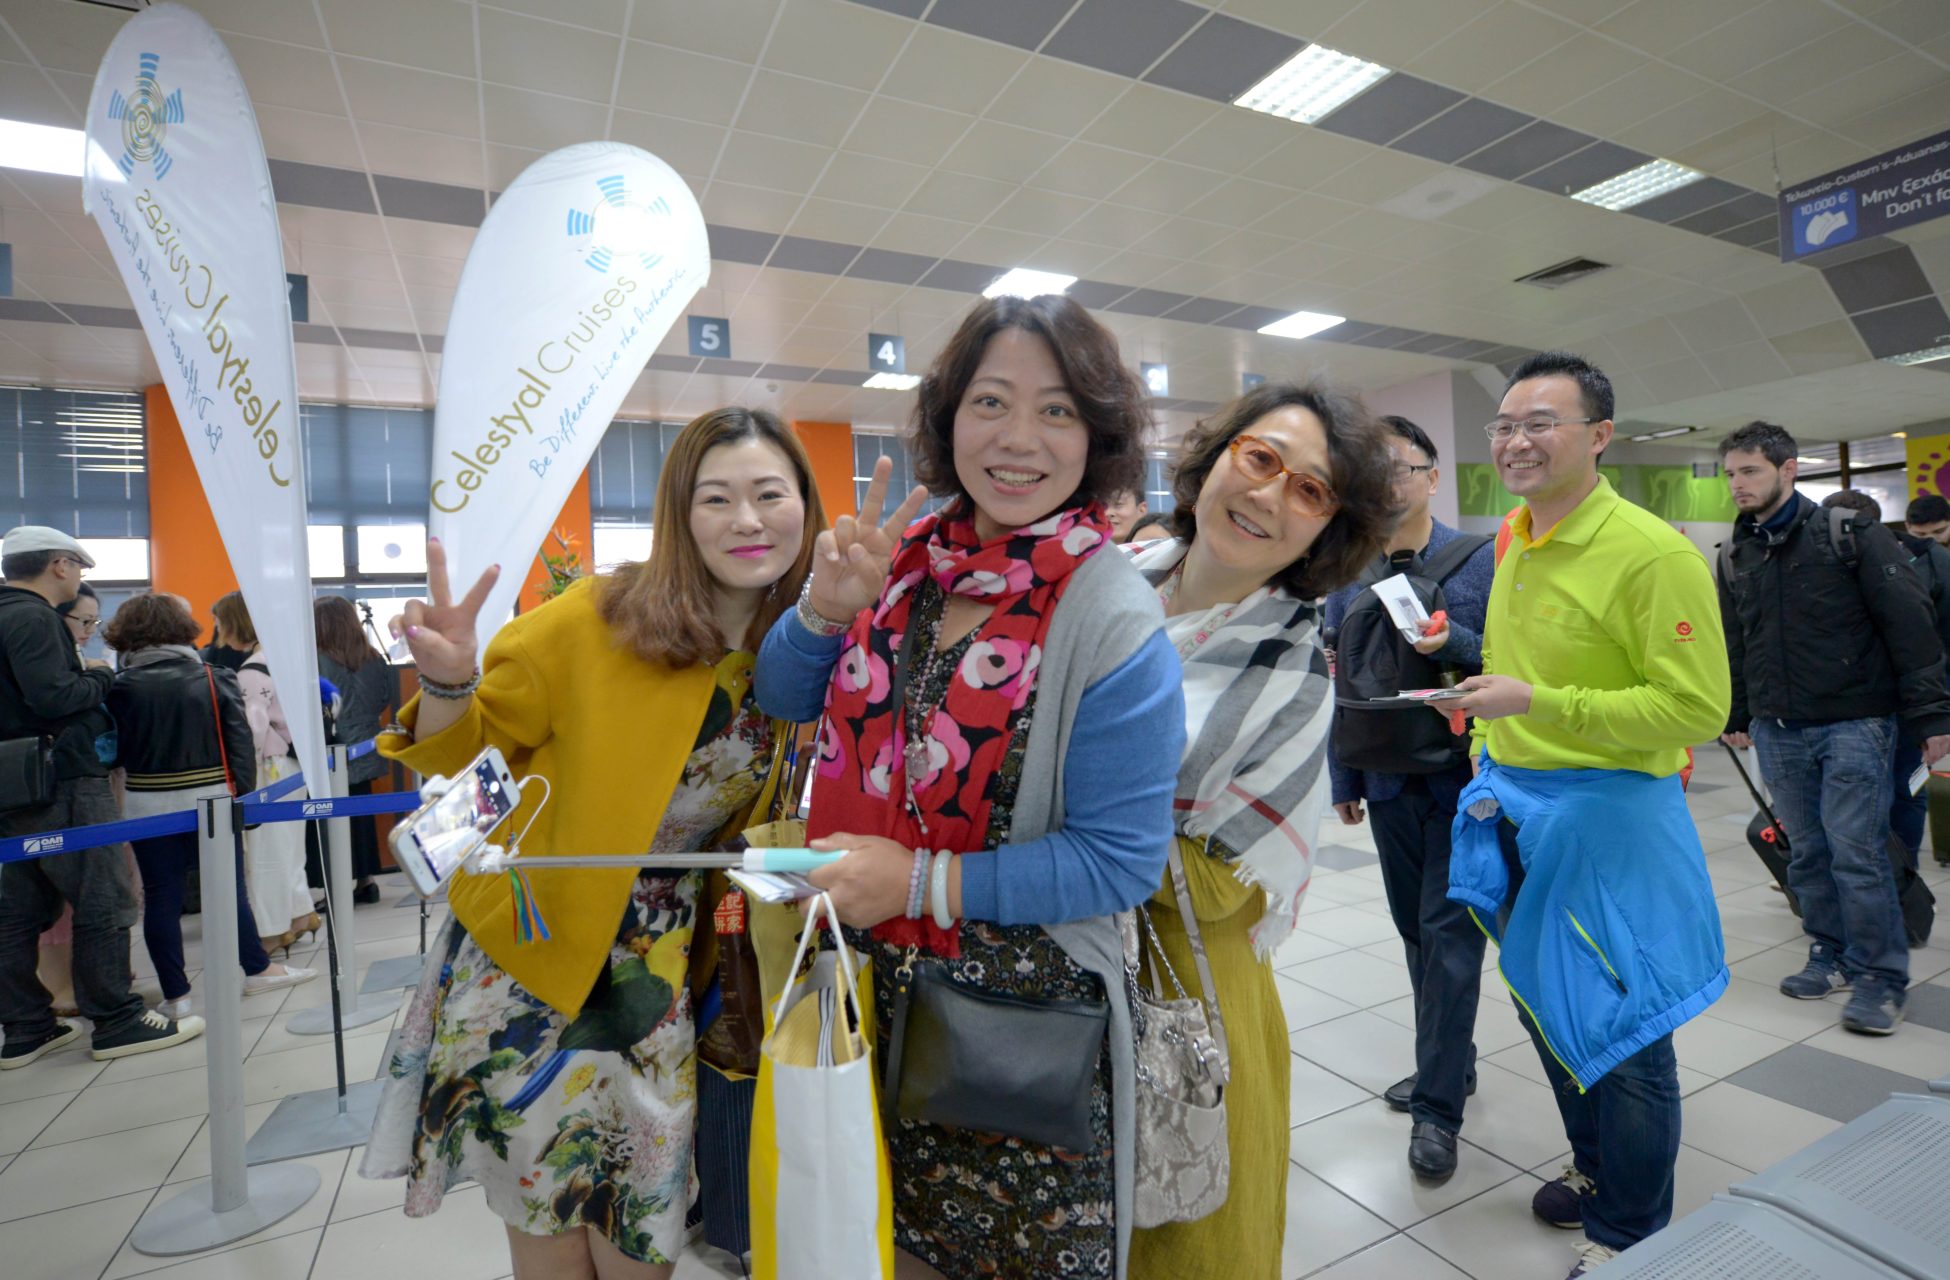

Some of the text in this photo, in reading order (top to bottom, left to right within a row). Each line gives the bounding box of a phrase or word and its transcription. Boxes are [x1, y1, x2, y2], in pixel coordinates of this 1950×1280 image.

[700, 323, 720, 351] 5
[877, 340, 896, 366] 4
[430, 276, 637, 514] Celestyal Cruises
[528, 455, 552, 479] Be
[593, 350, 620, 380] Live
[620, 325, 638, 351] the
